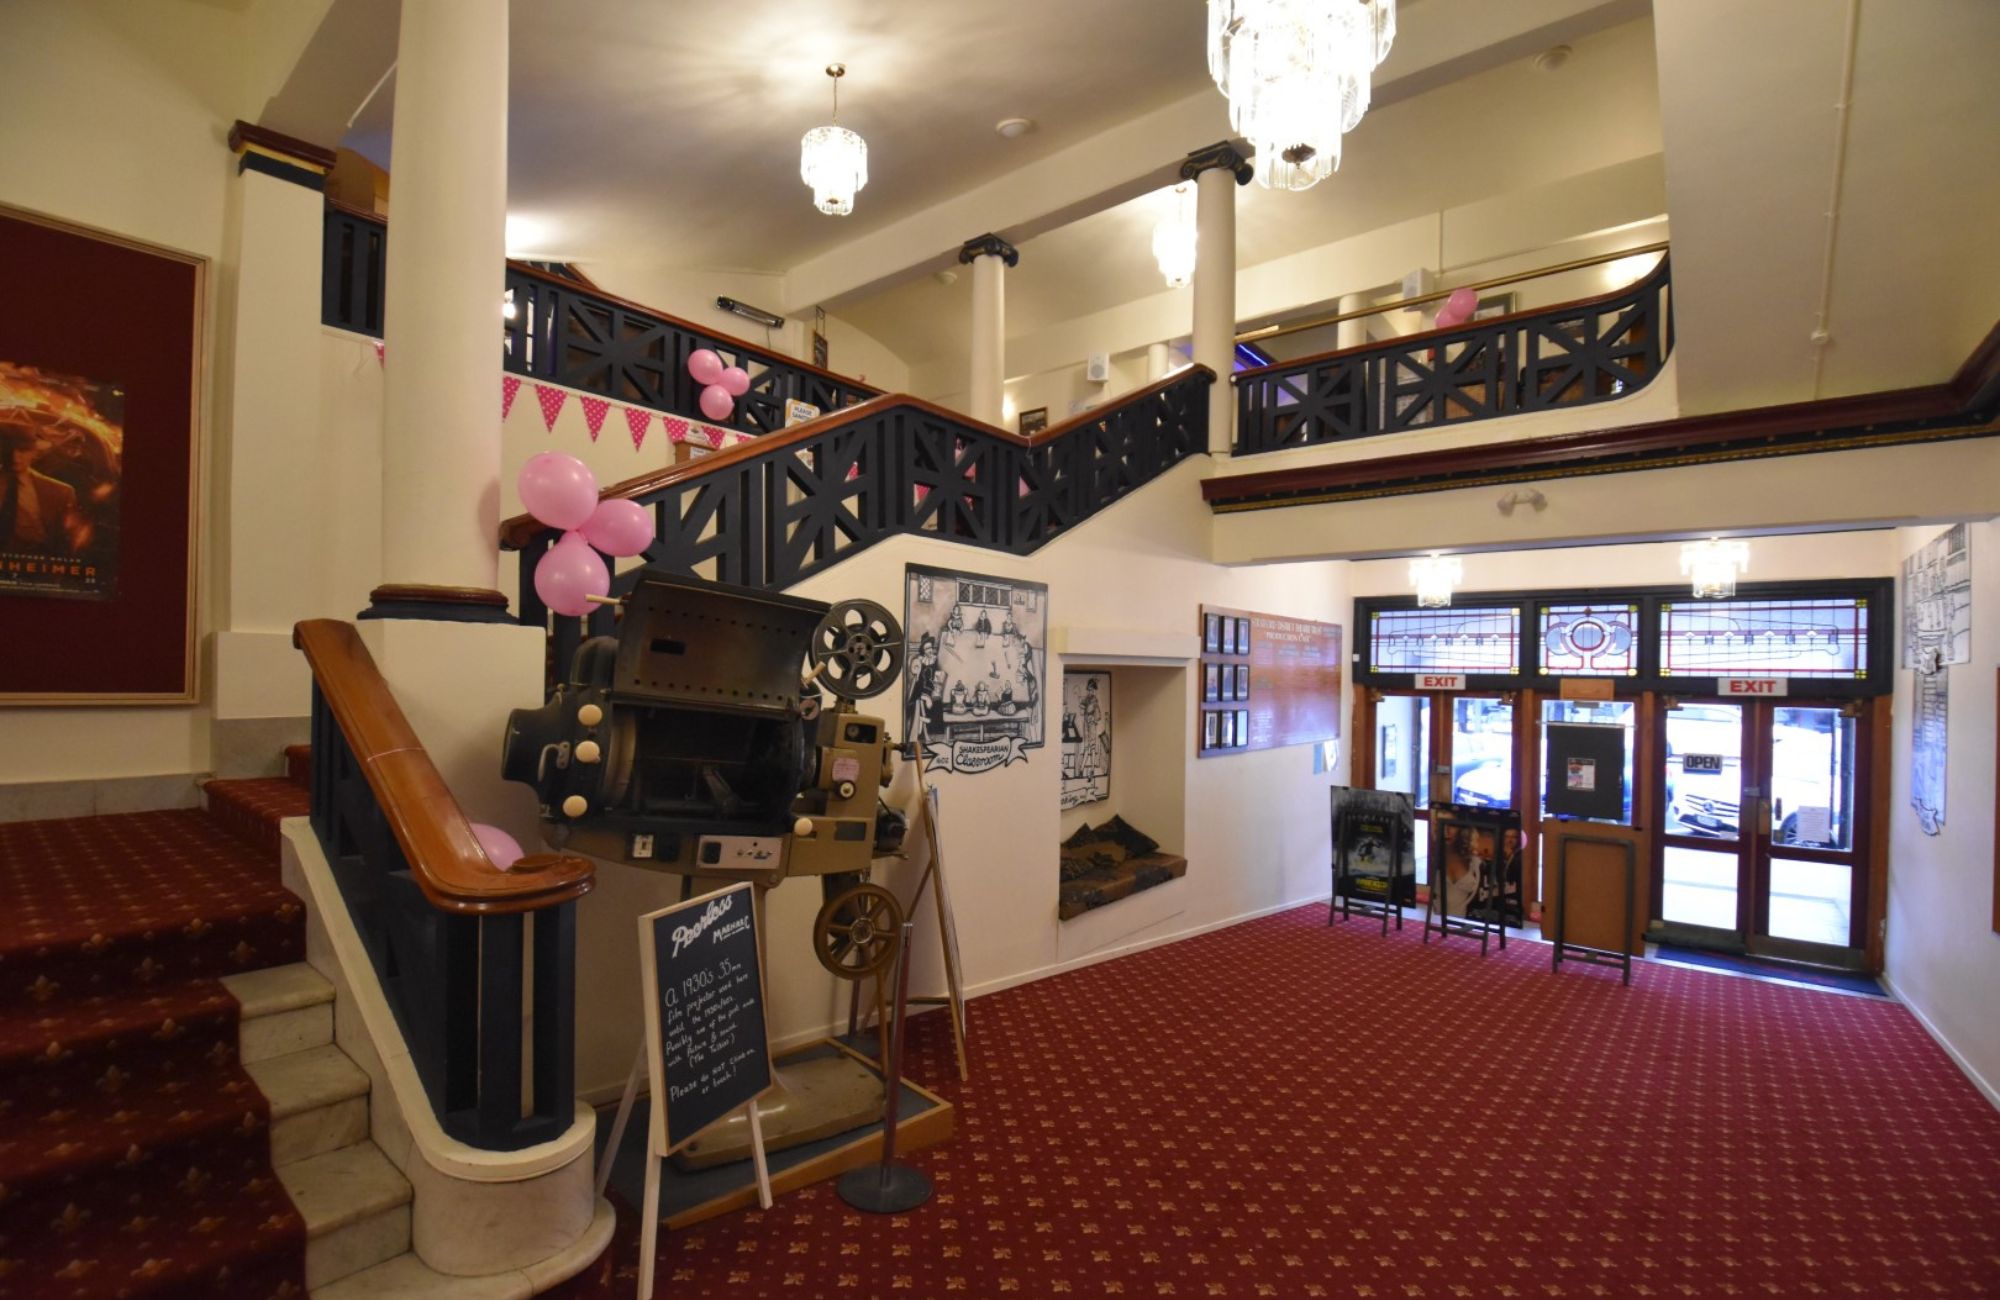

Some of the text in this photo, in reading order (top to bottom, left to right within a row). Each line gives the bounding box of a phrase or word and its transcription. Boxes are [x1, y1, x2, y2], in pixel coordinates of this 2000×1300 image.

[1424, 676, 1457, 688] EXIT
[1730, 680, 1776, 694] EXIT
[1686, 755, 1720, 769] OPEN
[672, 895, 733, 959] Peerless
[668, 1007, 683, 1025] film
[670, 1080, 697, 1102] Please
[712, 1061, 726, 1075] NOT
